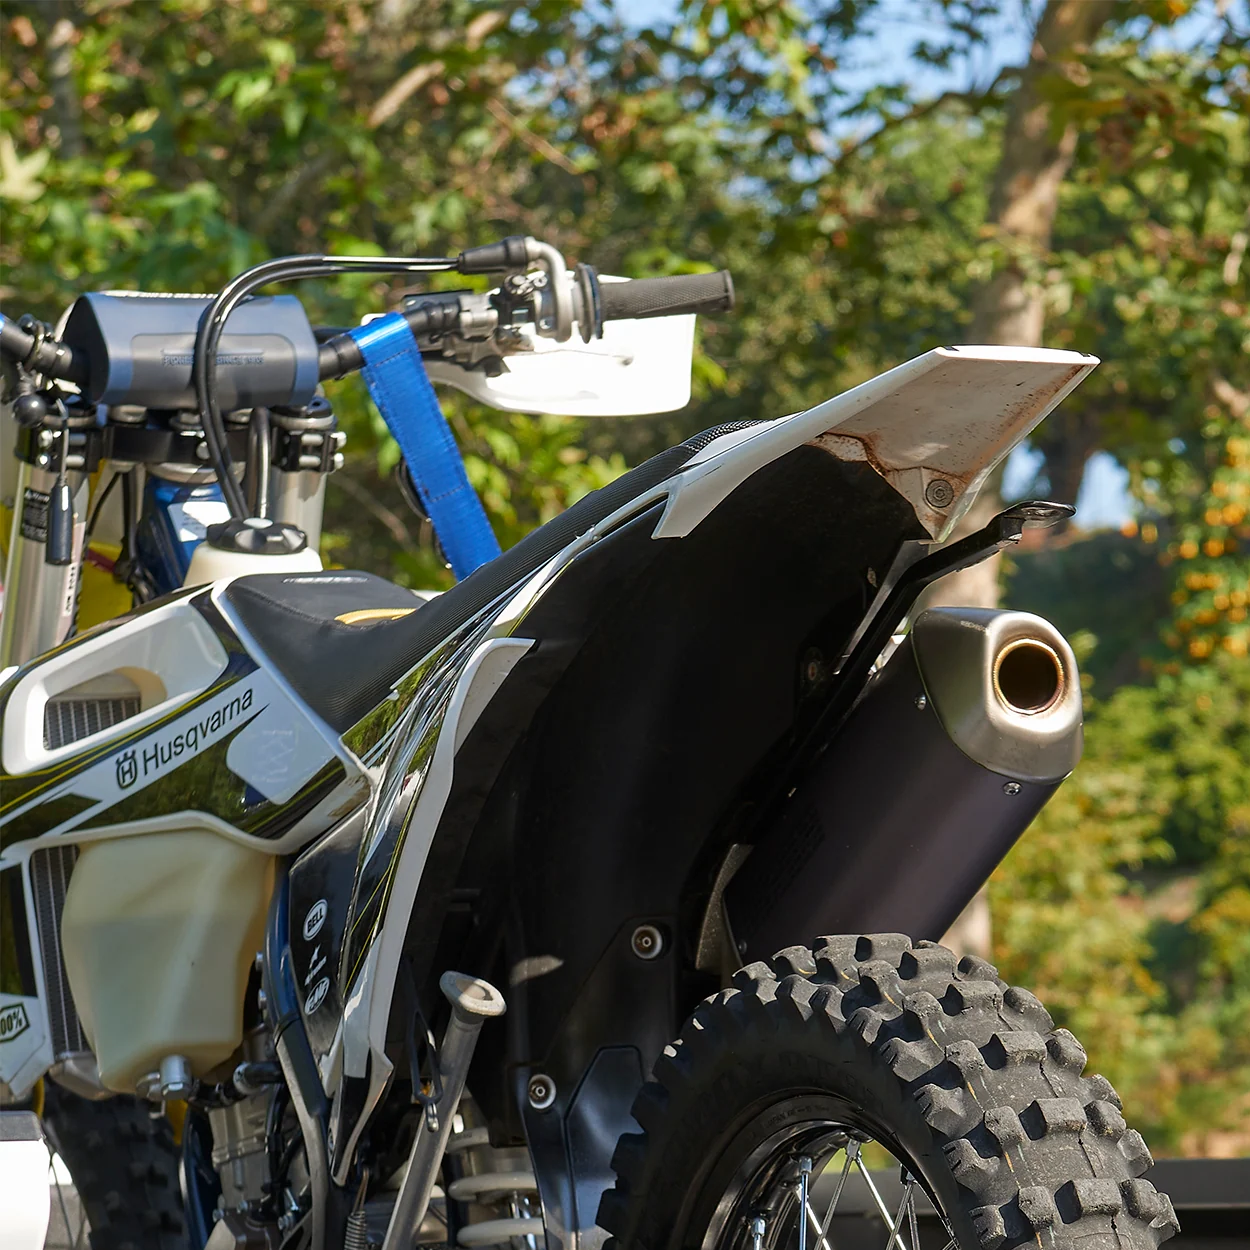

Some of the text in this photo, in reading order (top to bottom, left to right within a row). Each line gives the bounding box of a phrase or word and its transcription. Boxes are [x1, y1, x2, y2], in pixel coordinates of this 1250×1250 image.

[142, 688, 253, 776] Husqvarna
[307, 907, 324, 933] BELL
[0, 1008, 23, 1036] 00%
